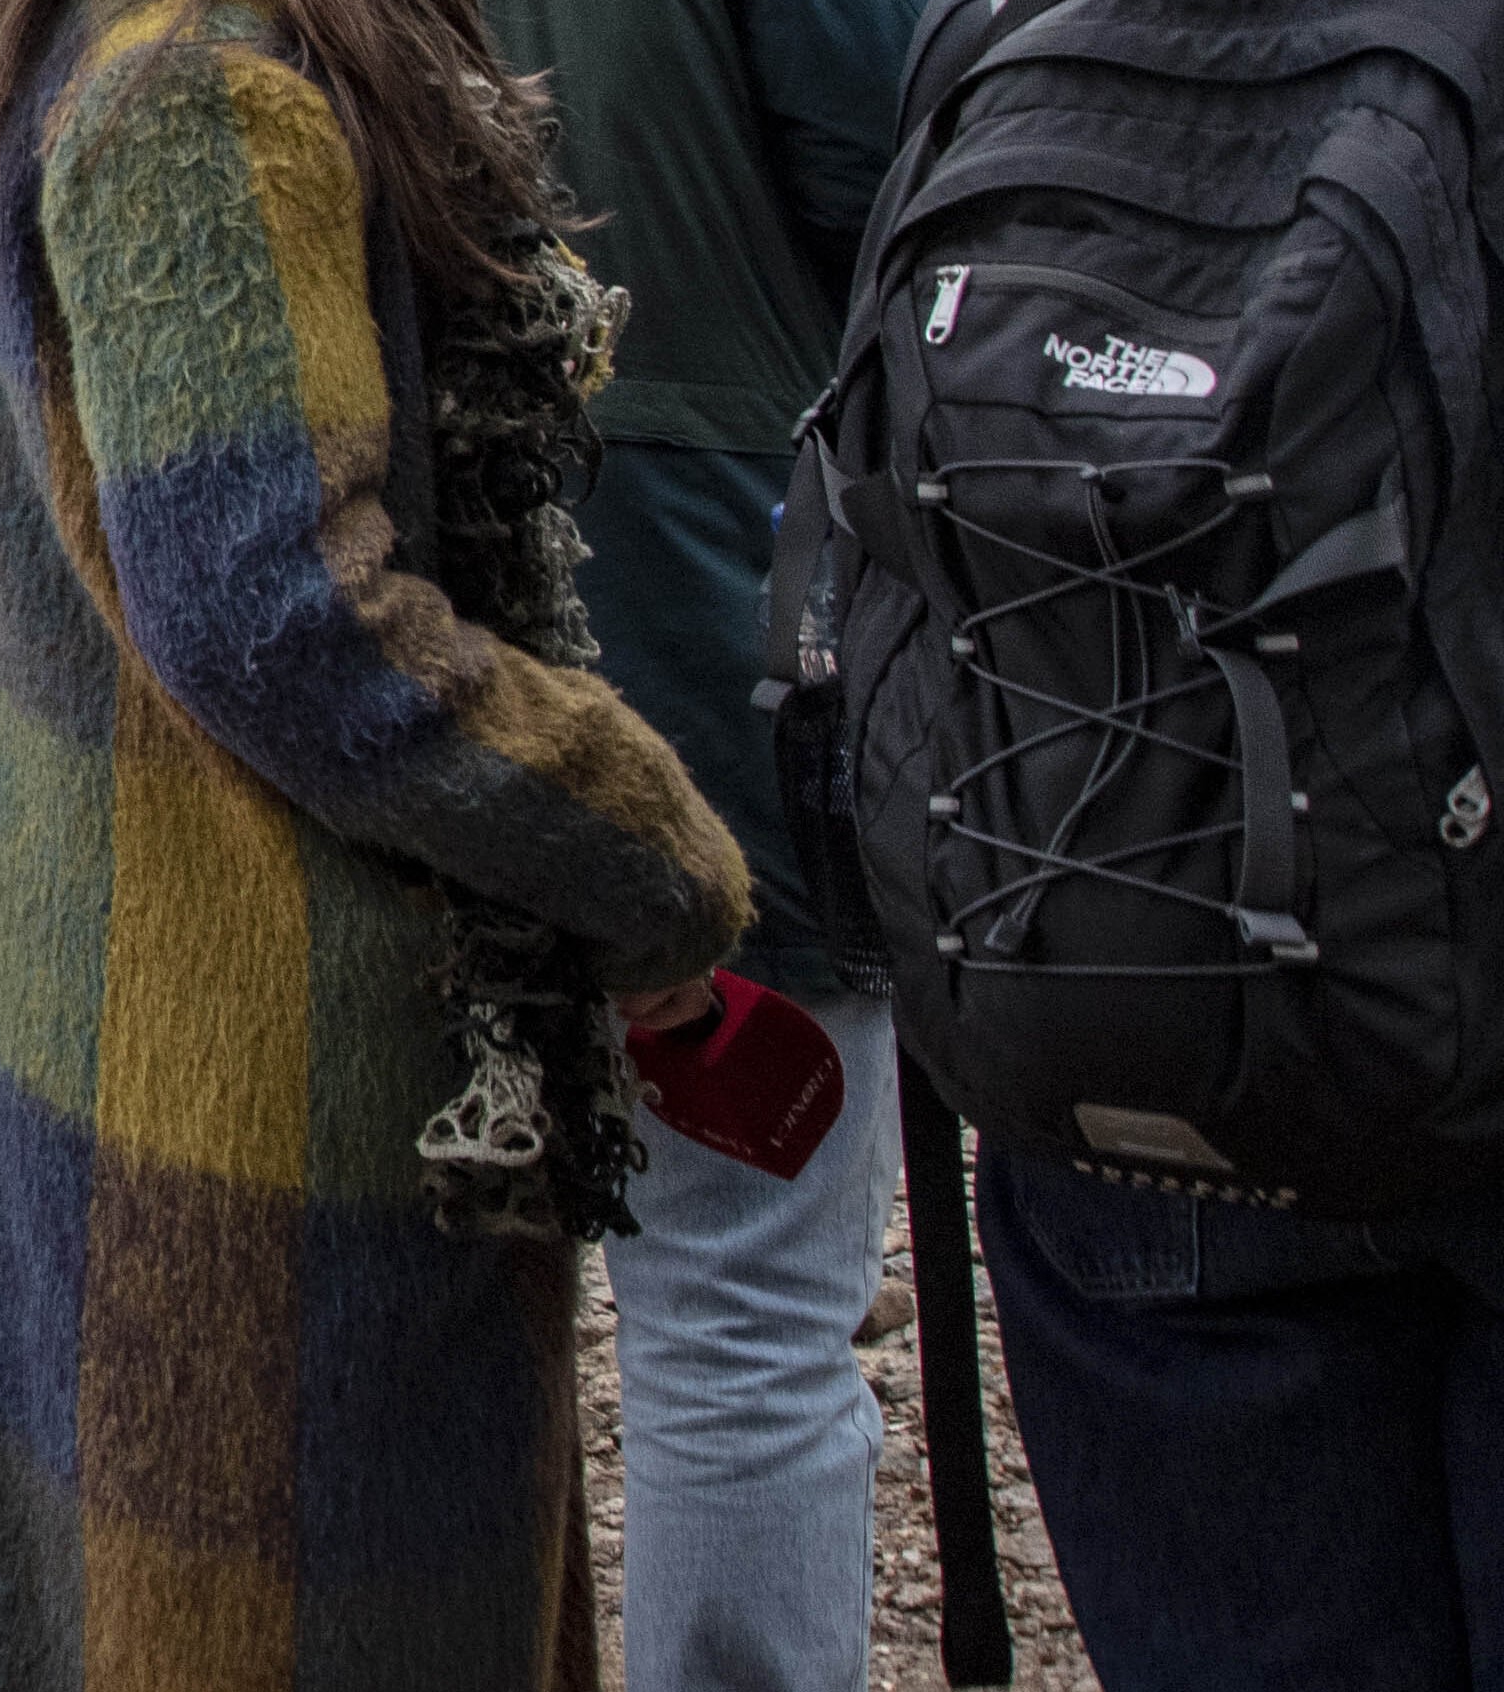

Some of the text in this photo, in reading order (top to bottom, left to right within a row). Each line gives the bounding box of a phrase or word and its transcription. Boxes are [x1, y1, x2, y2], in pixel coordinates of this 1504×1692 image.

[1044, 333, 1161, 384] NORTH
[1105, 334, 1170, 363] THE
[1062, 368, 1149, 394] FACE
